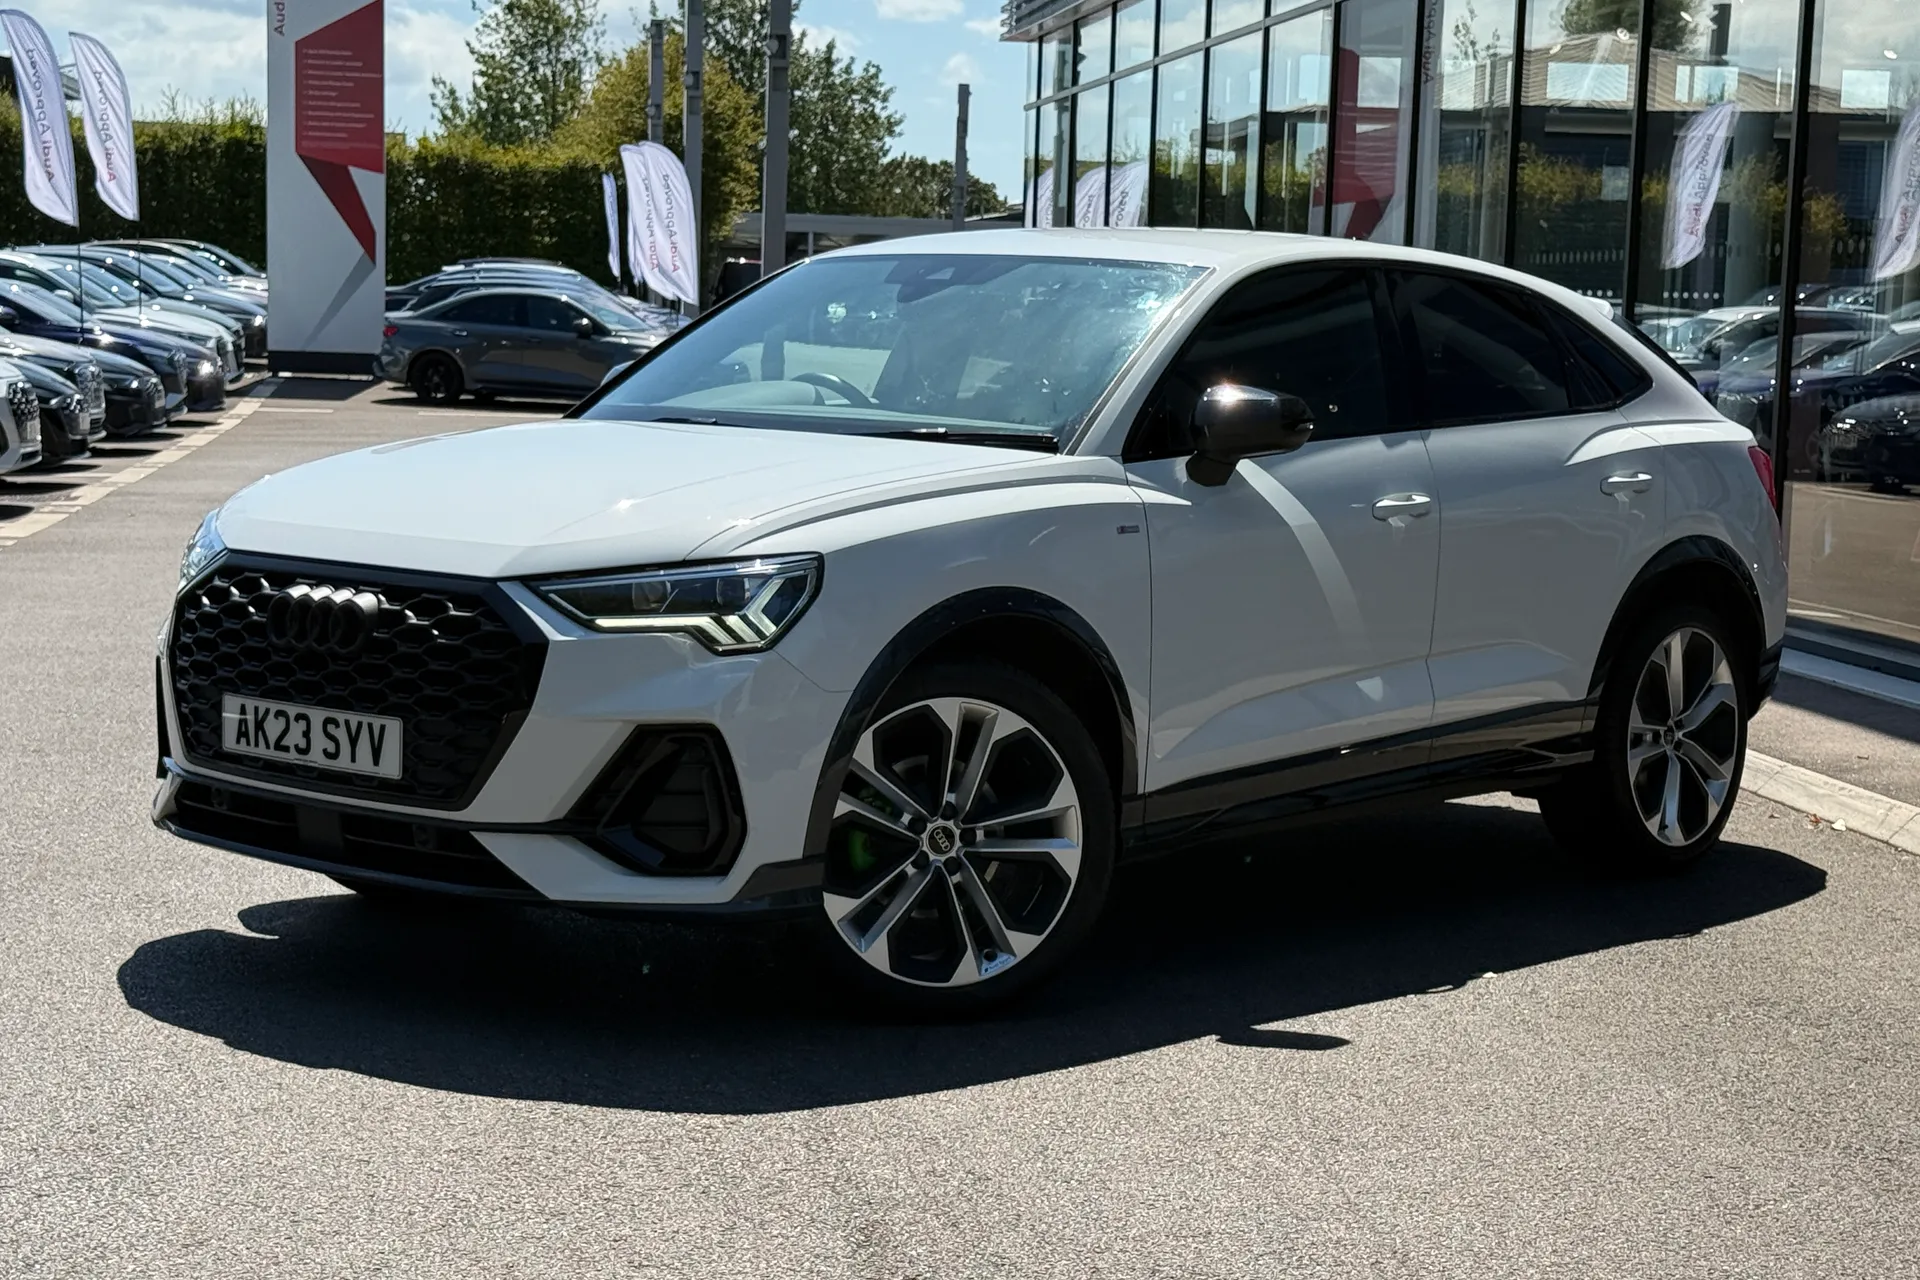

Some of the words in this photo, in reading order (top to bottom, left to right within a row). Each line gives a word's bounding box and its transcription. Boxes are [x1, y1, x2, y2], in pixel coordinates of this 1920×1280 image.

[273, 0, 286, 37] Aud
[236, 703, 311, 756] AK23
[322, 716, 386, 767] SYV
